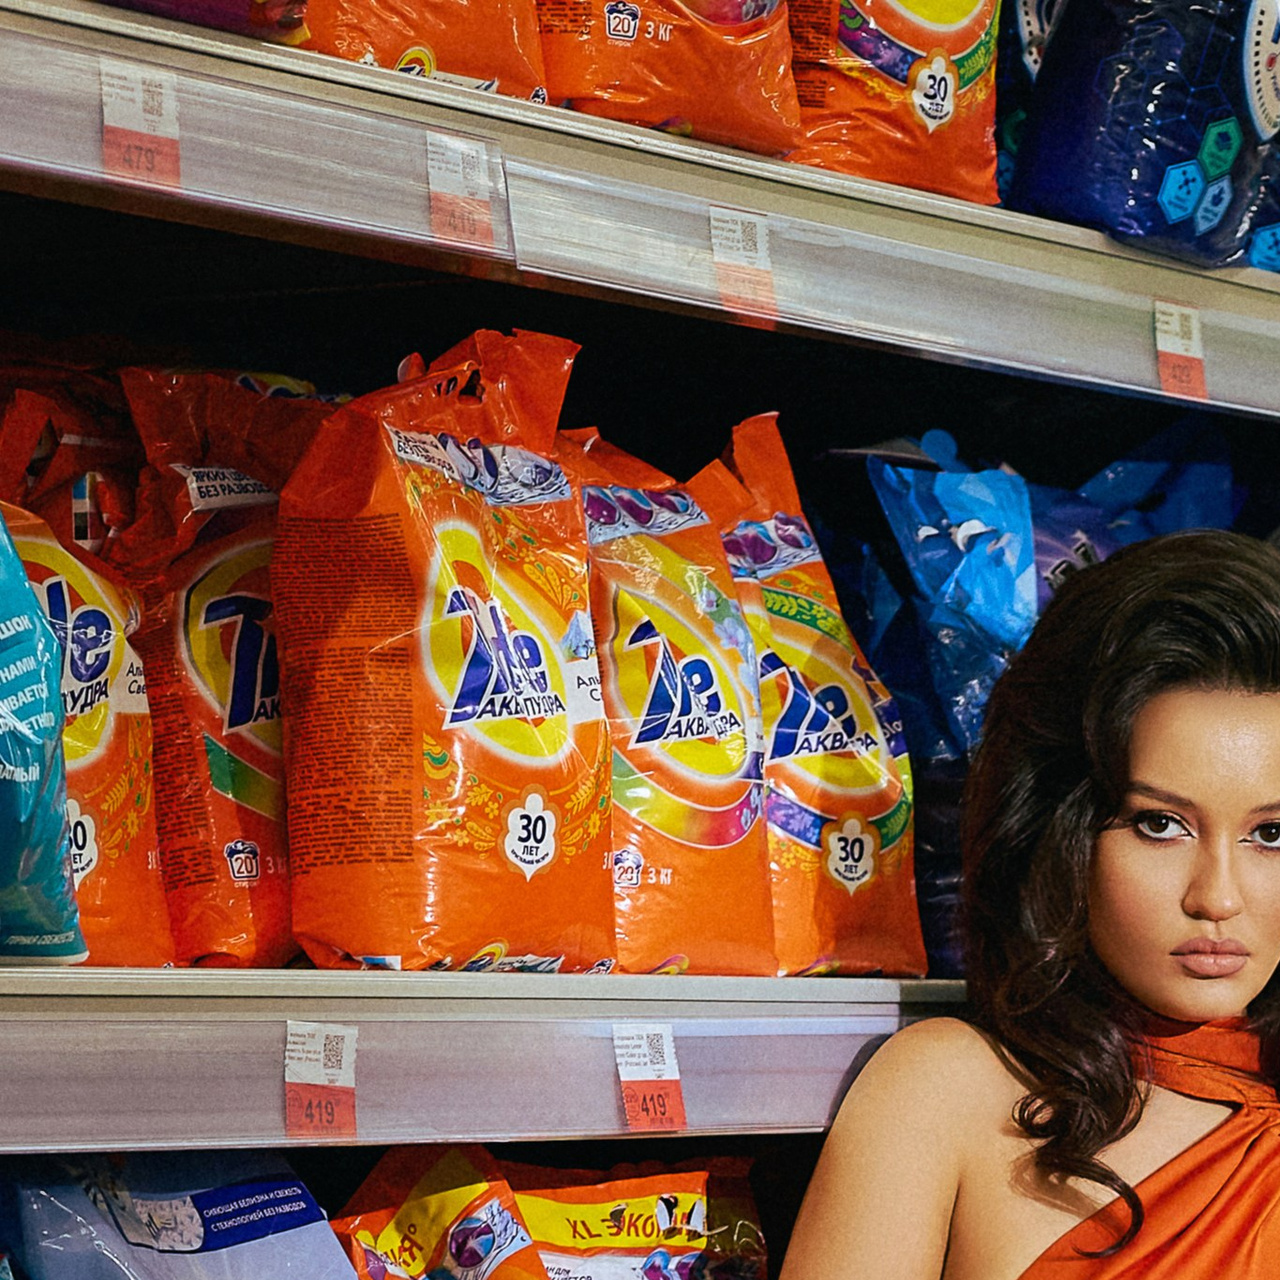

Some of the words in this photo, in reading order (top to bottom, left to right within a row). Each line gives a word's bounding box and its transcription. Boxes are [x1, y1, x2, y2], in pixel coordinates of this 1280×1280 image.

[611, 15, 631, 33] 20
[645, 21, 654, 38] 3
[923, 73, 948, 101] 30
[197, 485, 219, 499] БЕЗ
[517, 814, 546, 844] 30
[522, 844, 540, 857] ЛЕТ
[837, 836, 865, 863] 30
[235, 857, 255, 876] 20
[647, 866, 658, 883] 3
[659, 867, 673, 885] КГ
[305, 1099, 335, 1125] 419
[641, 1093, 667, 1117] 419
